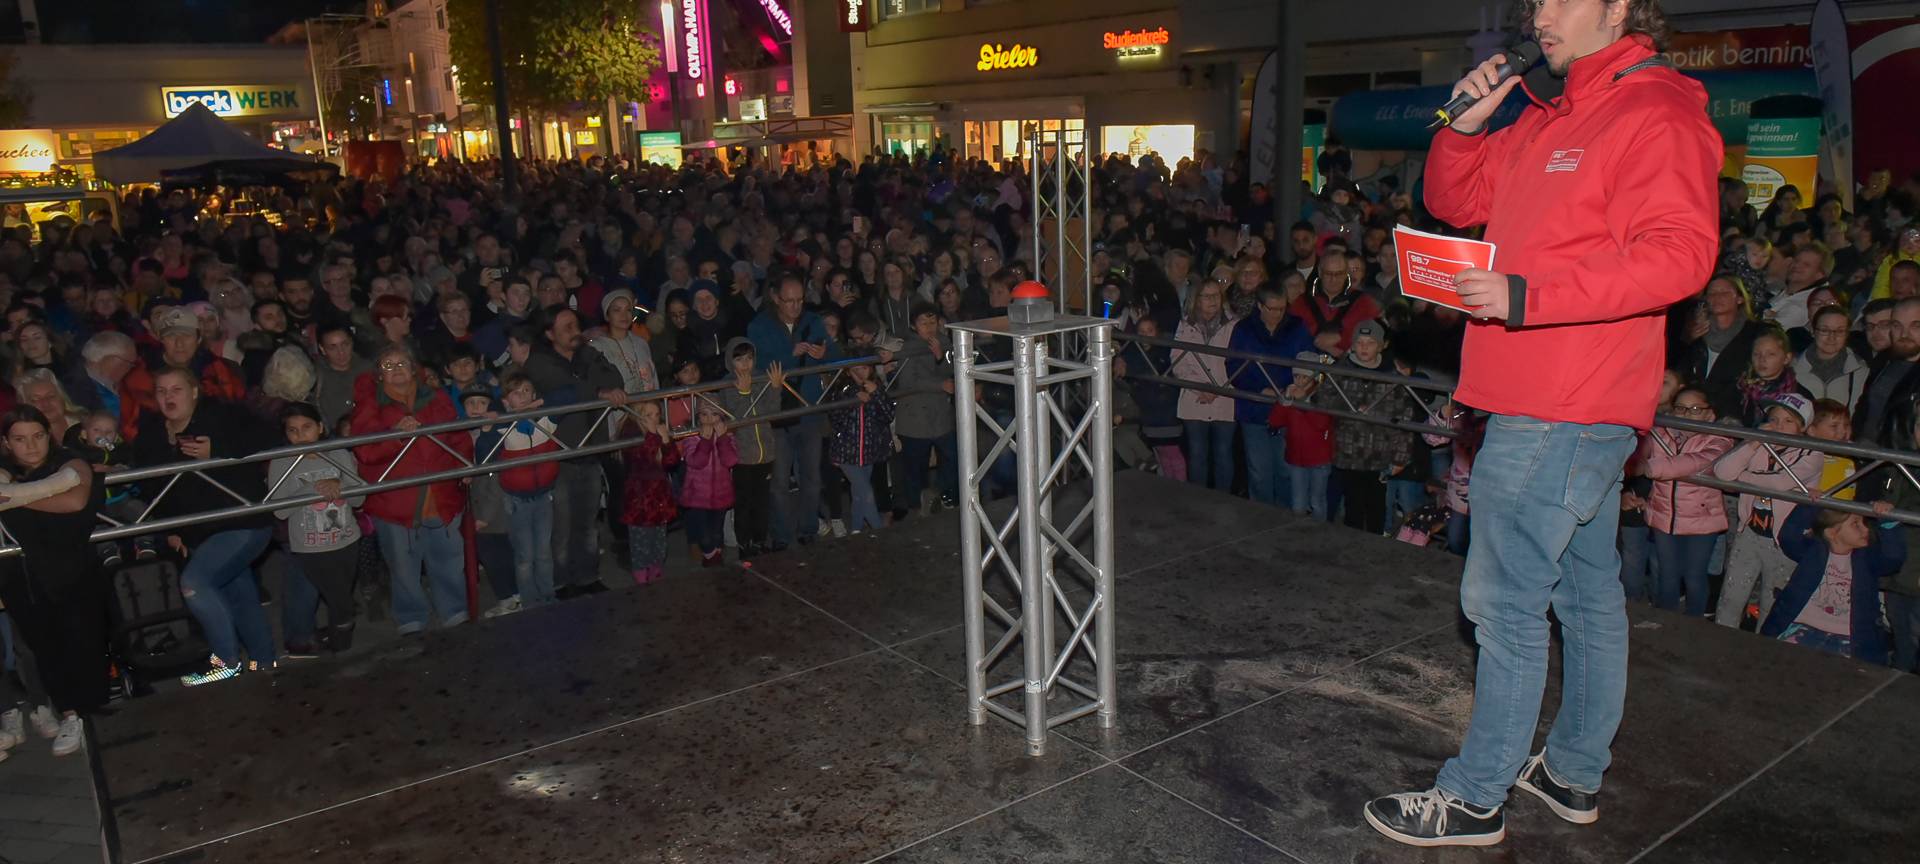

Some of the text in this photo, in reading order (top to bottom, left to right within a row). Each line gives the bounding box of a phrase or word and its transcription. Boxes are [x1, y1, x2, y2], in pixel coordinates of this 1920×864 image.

[1103, 27, 1169, 49] Studienkreis
[686, 33, 701, 78] OLYMP
[976, 44, 1038, 71] Dieler
[1722, 40, 1815, 68] benning
[236, 90, 299, 109] WERK
[1410, 254, 1430, 266] 98.7
